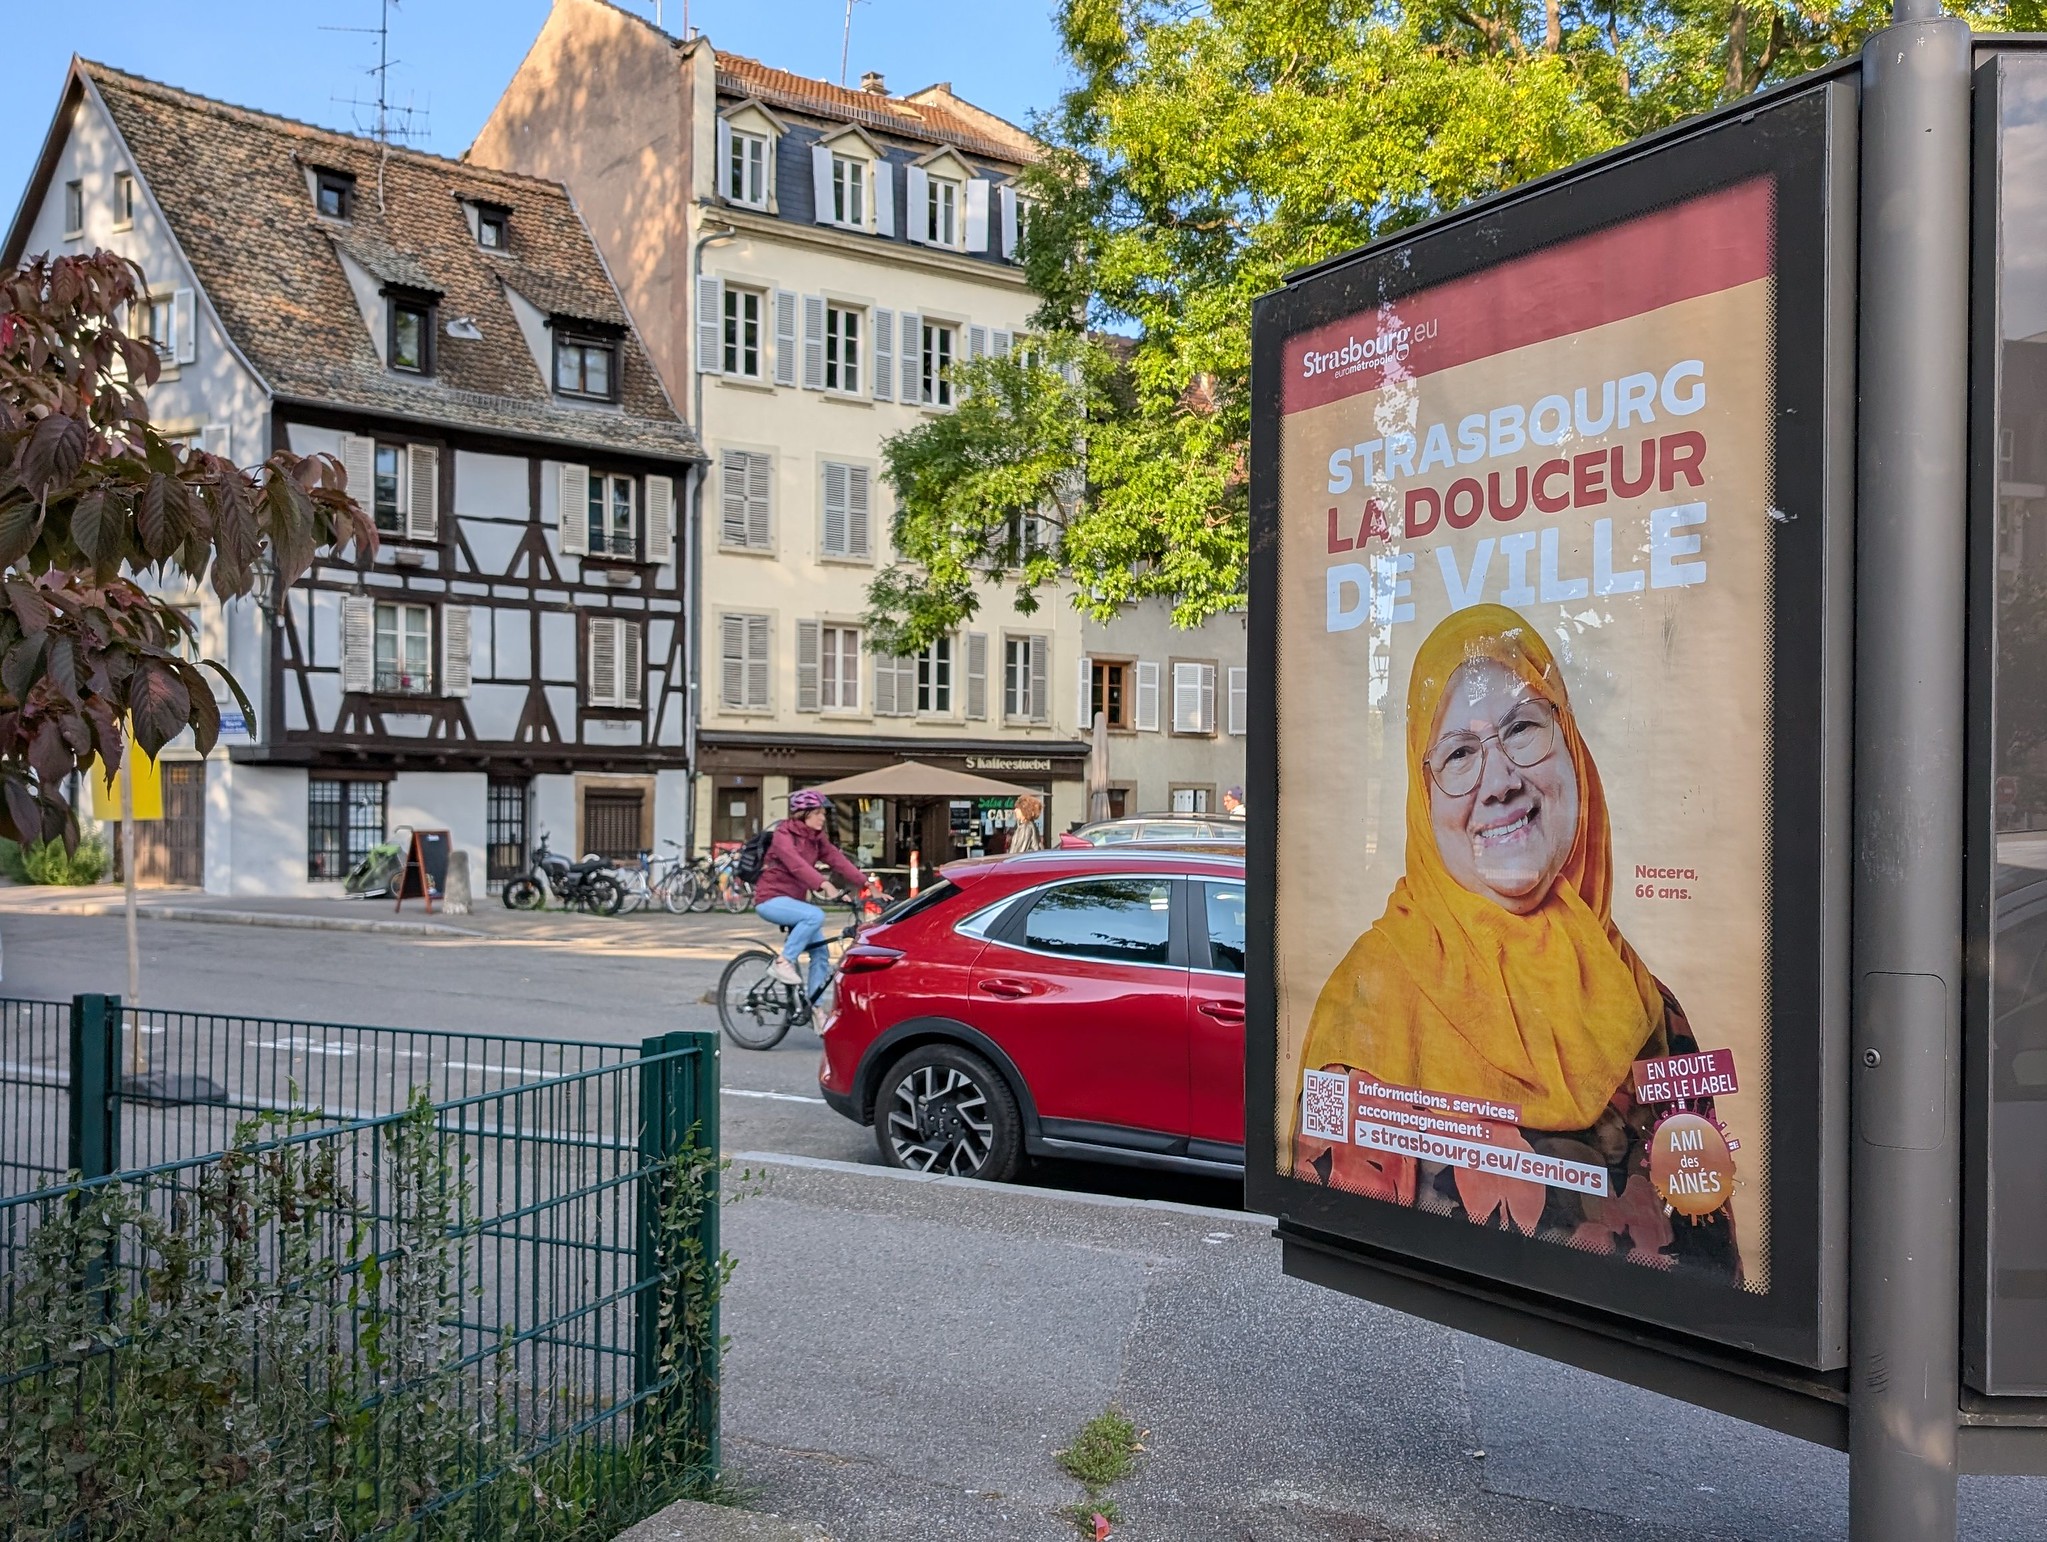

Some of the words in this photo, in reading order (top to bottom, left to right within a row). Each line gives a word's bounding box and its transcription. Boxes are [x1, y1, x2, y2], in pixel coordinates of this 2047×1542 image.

[1303, 319, 1438, 378] Strasbourg.eu
[1334, 354, 1393, 379] eurométropole
[1327, 359, 1706, 494] STRASBOURG
[1327, 499, 1392, 554] LA
[1404, 430, 1707, 540] DOUCEUR
[1326, 552, 1416, 632] DE
[1435, 501, 1707, 608] VILLE
[987, 809, 1016, 821] CAF
[1635, 865, 1698, 881] Nacera,
[1635, 884, 1655, 898] 66
[1658, 888, 1692, 900] ans.
[1647, 1061, 1666, 1080] EN
[1668, 1054, 1716, 1078] ROUTE
[1358, 1081, 1450, 1111] Informations,
[1453, 1098, 1519, 1123] services,
[1638, 1082, 1671, 1102] VERS
[1674, 1079, 1690, 1098] LE
[1692, 1073, 1737, 1096] LABEL
[1358, 1105, 1483, 1138] accompagnement
[1670, 1129, 1704, 1152] AMI
[1371, 1127, 1602, 1189] strasbourg.eu/seniors
[1680, 1155, 1699, 1168] des
